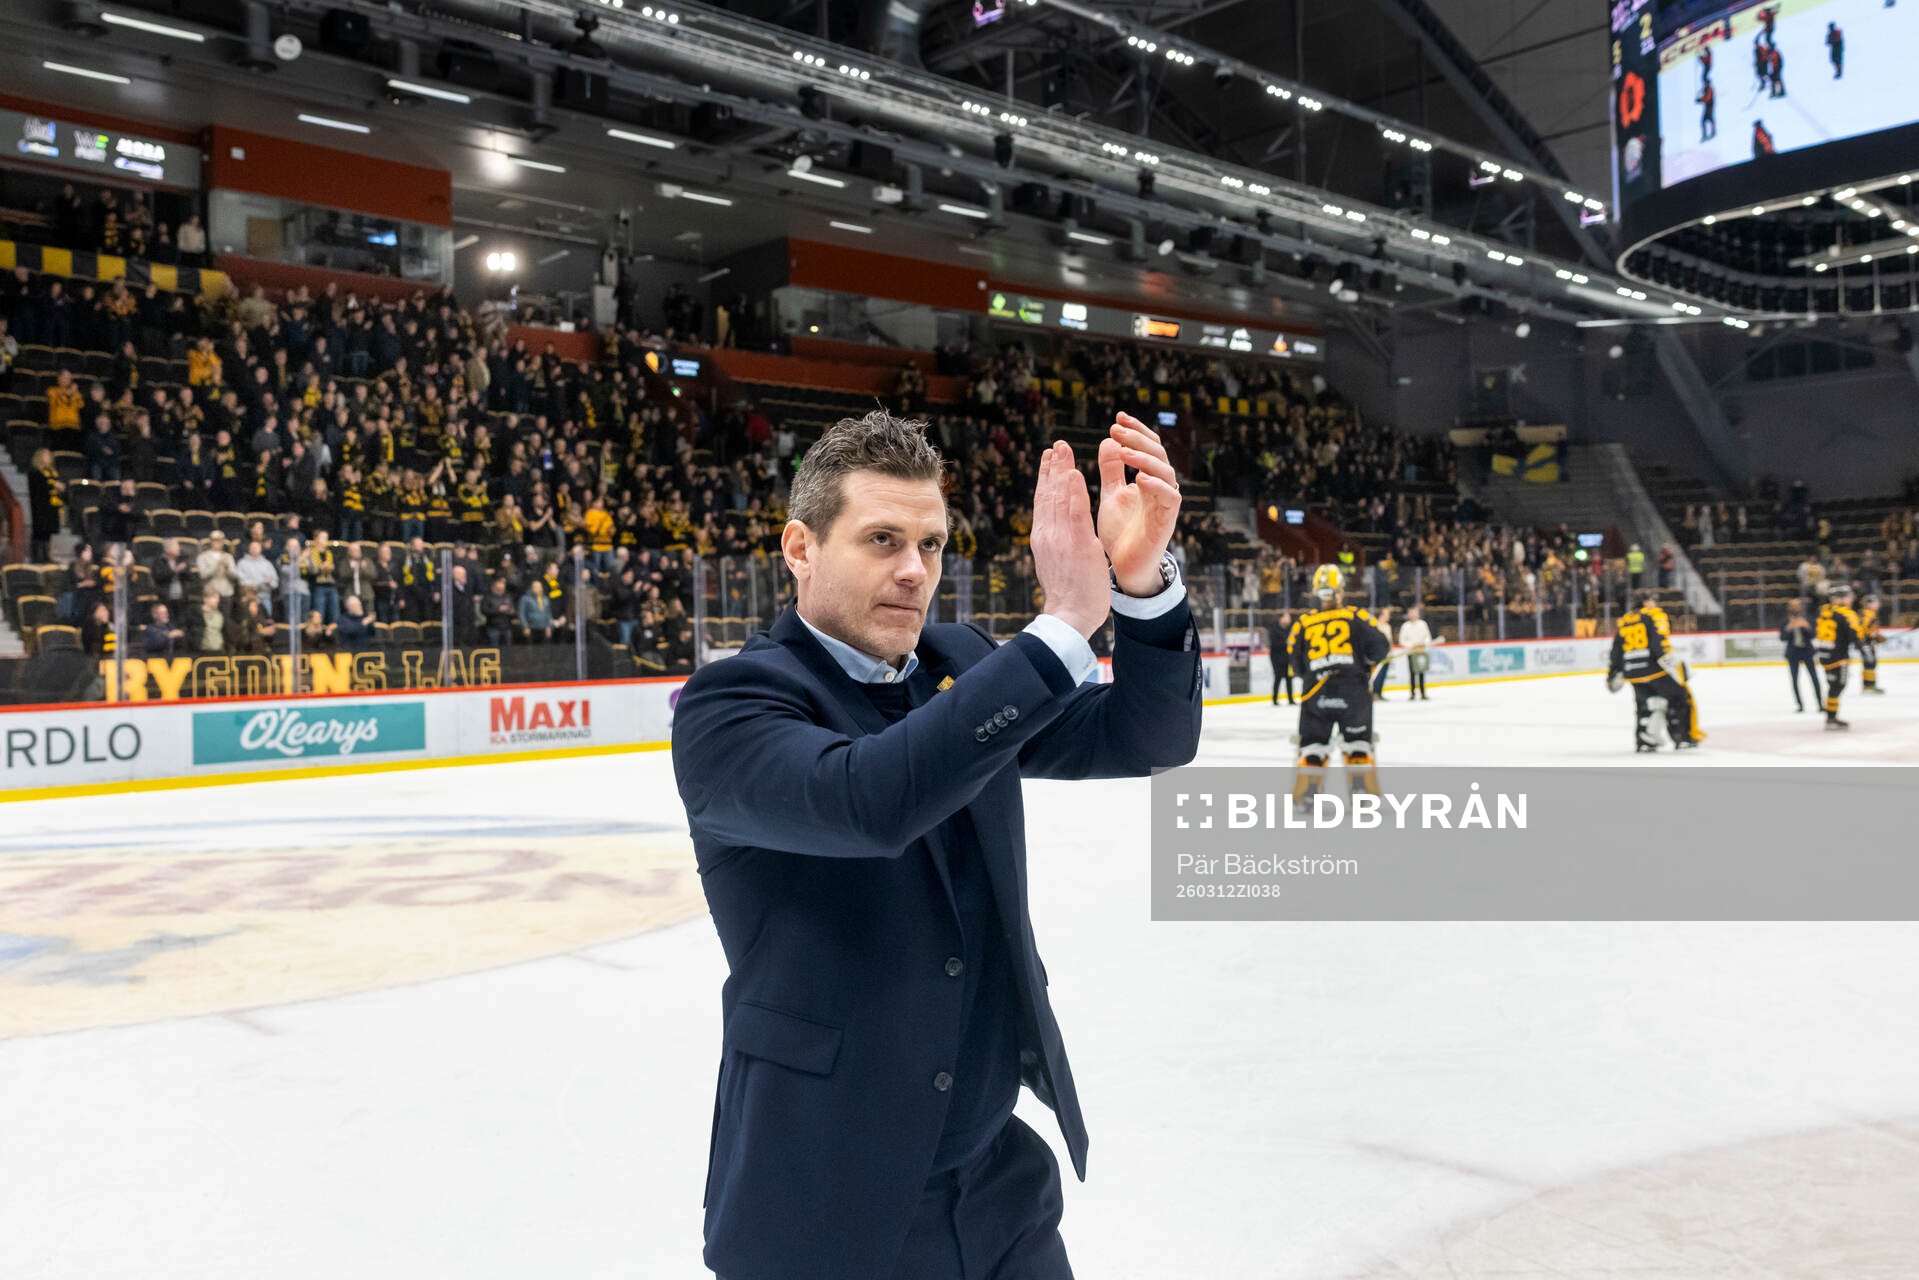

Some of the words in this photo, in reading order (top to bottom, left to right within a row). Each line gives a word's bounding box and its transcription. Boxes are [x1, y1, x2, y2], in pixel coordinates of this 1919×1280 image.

[1304, 620, 1353, 660] 32
[240, 706, 378, 756] O'Learys
[490, 696, 590, 732] MAXI
[7, 722, 141, 768] RDLO
